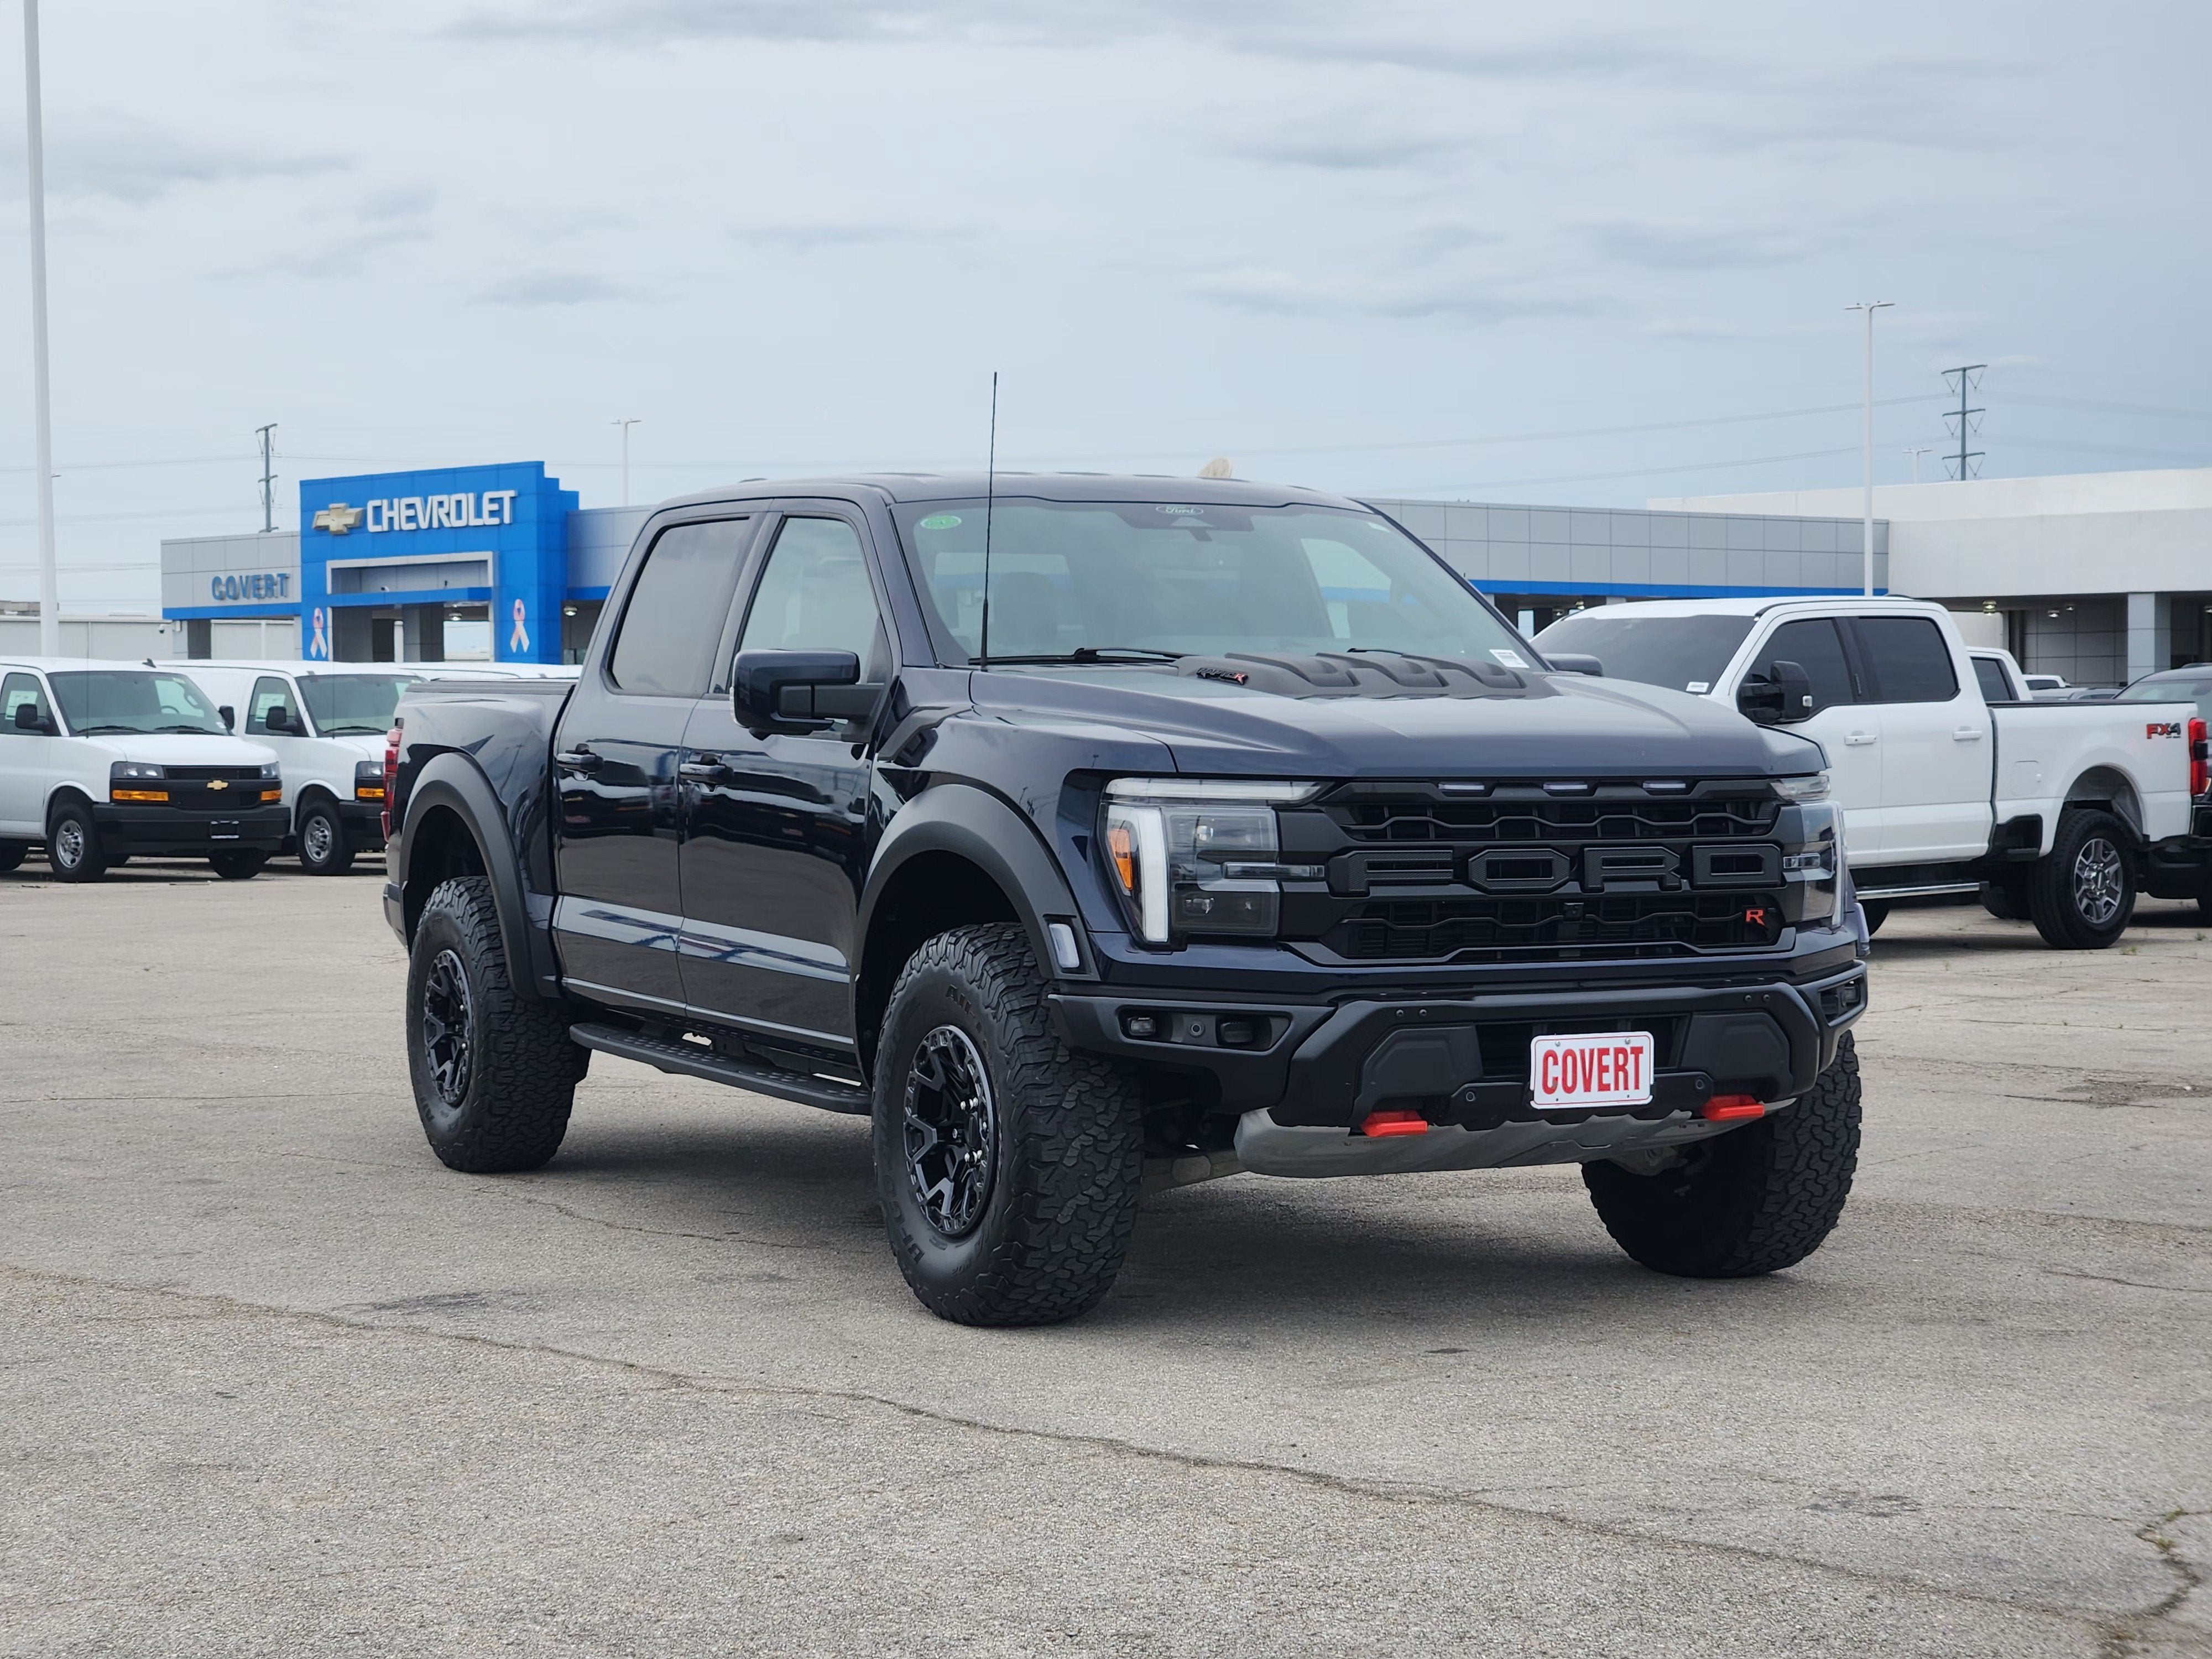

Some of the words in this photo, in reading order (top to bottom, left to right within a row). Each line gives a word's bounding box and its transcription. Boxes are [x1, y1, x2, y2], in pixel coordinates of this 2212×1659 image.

[367, 490, 517, 533] CHEVROLET
[212, 573, 290, 601] COVERT
[1196, 667, 1248, 685] RAPTOR
[2146, 723, 2181, 739] FX4
[1329, 843, 1782, 893] FORD
[1745, 909, 1765, 926] R
[1542, 1046, 1644, 1095] COVERT
